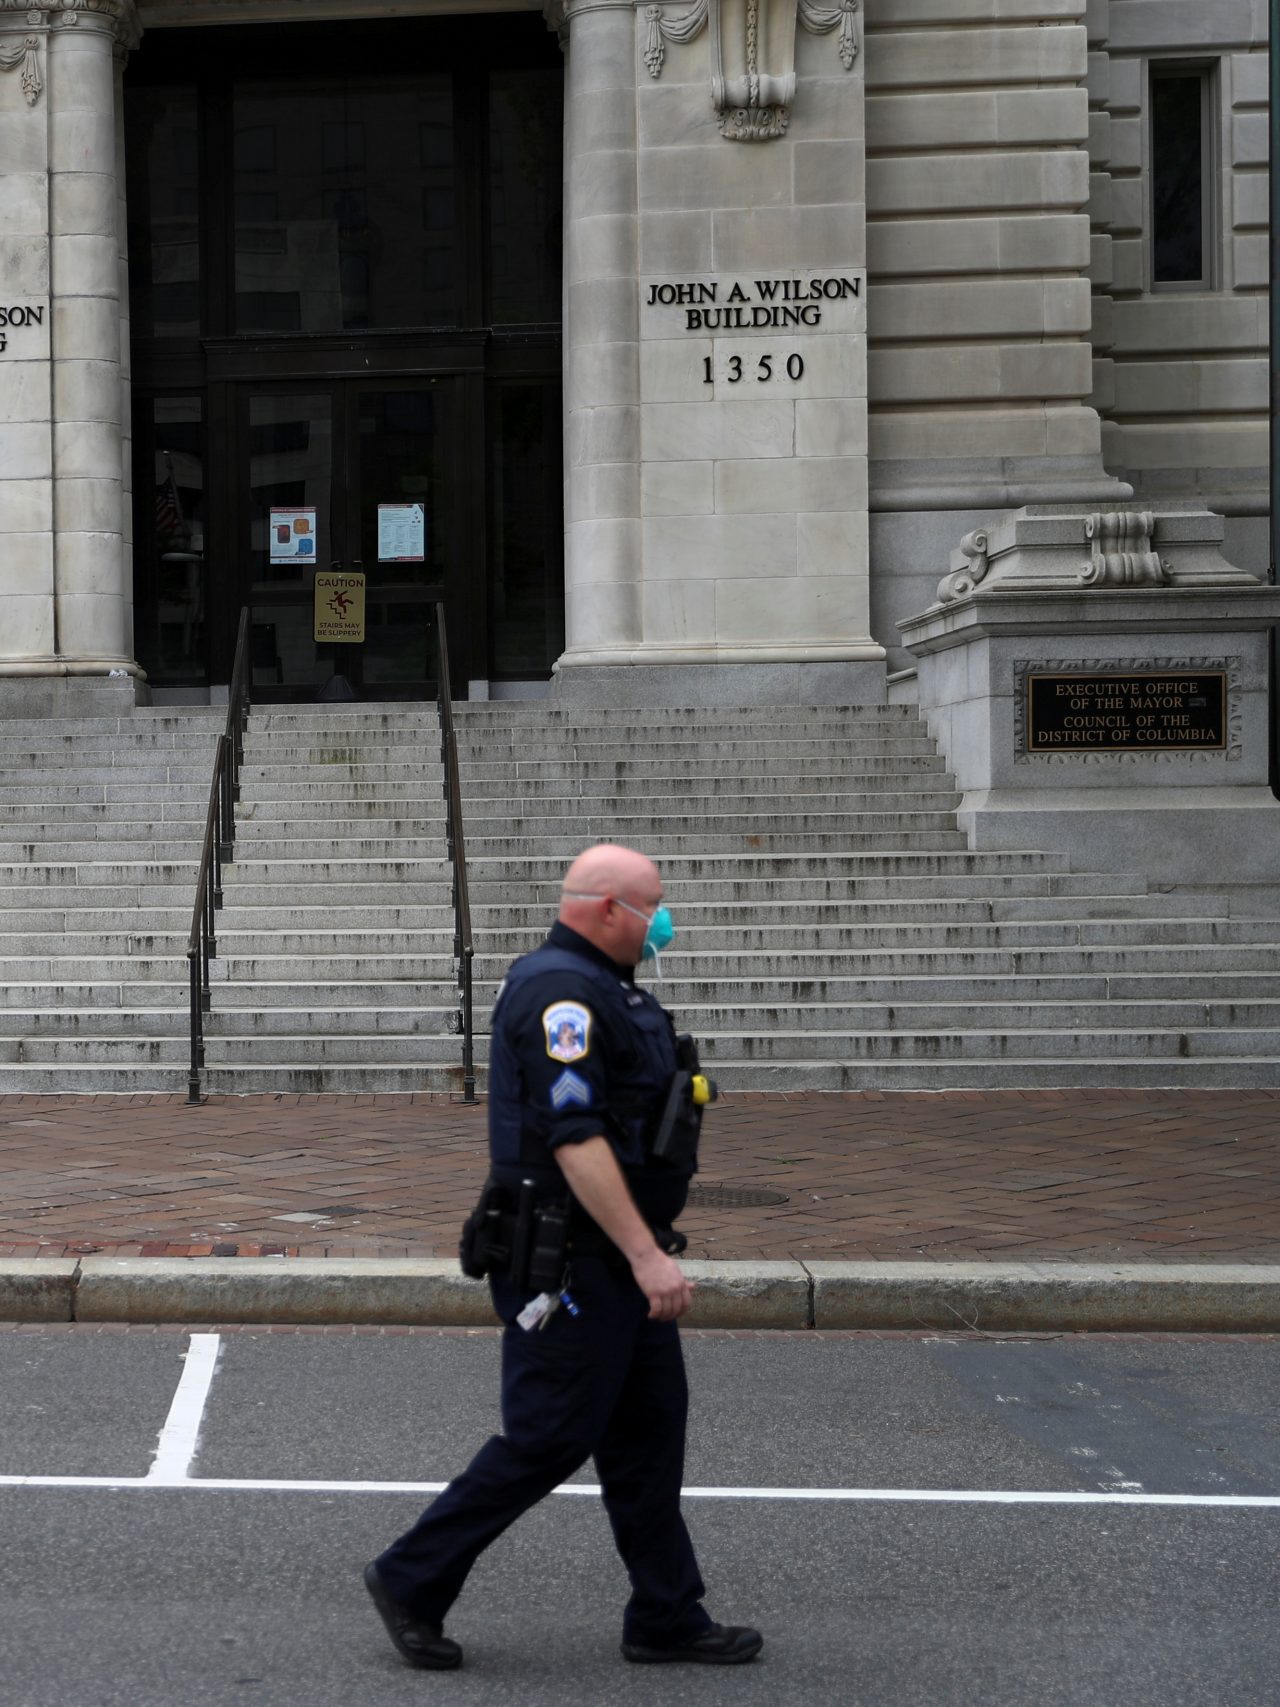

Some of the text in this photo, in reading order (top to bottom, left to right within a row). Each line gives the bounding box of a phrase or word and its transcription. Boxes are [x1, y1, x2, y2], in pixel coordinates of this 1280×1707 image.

[647, 277, 861, 305] JOHN A. WILSON
[686, 305, 821, 330] BUILDING
[317, 578, 363, 587] CAUTION
[1056, 682, 1198, 696] EXECUTIVE OFFICE
[1070, 696, 1183, 710] OF THE MAYOR
[1063, 715, 1190, 728] COUNCIL OF THE
[1038, 728, 1216, 742] DISTRICT OF COLUMBIA
